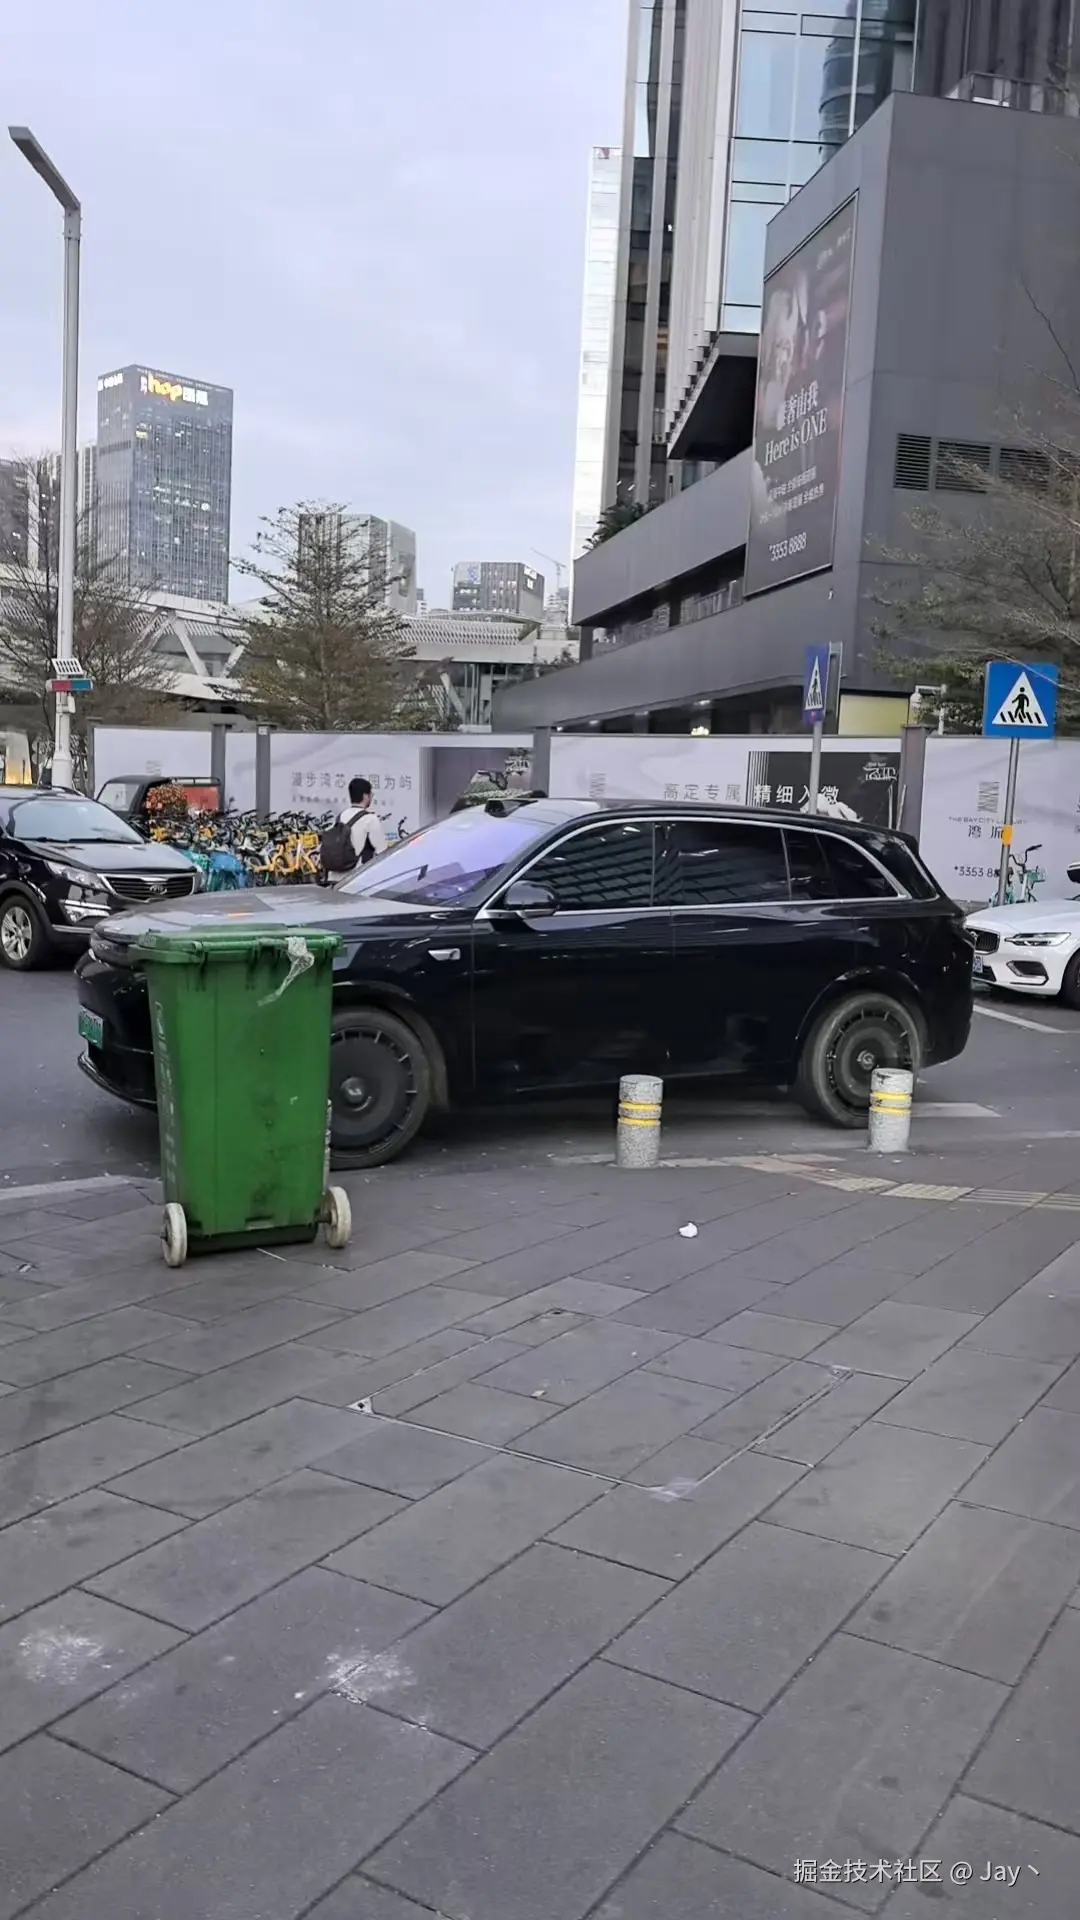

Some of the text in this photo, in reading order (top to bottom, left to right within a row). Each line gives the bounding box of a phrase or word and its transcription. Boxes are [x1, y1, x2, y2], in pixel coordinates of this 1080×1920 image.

[764, 407, 828, 466] Here is ONE
[789, 532, 807, 555] 8888
[663, 783, 840, 805] 高定专属 精细入微
